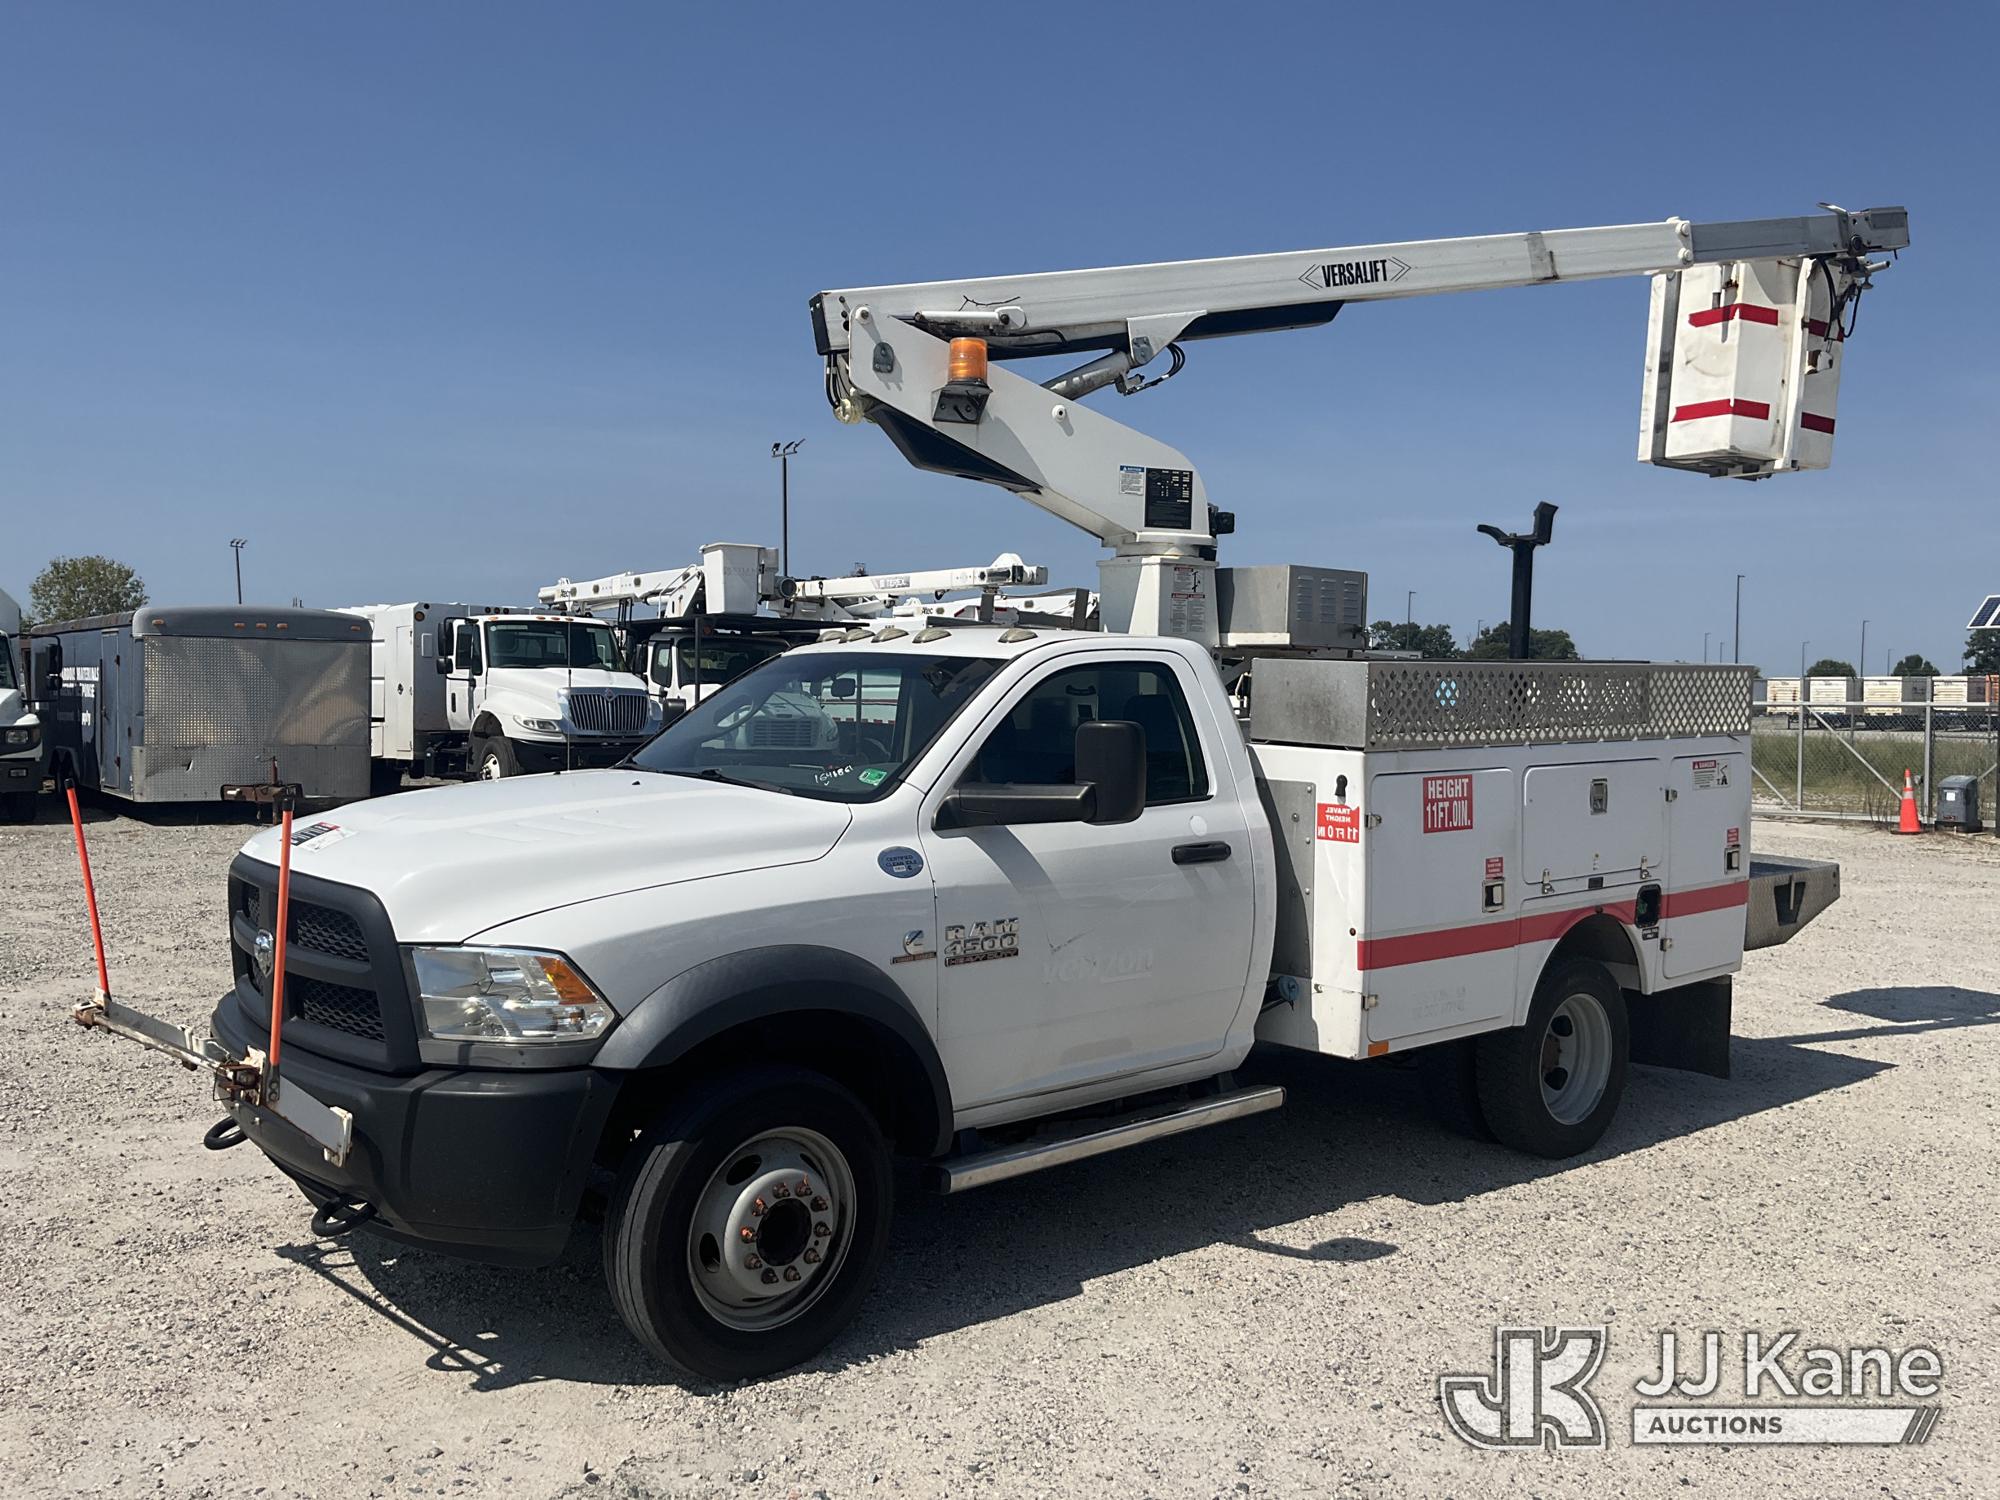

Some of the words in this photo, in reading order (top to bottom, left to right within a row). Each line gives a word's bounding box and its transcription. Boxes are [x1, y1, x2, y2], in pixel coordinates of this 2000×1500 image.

[1321, 259, 1388, 288] VERSALIFT
[1427, 778, 1469, 799] HEIGHT
[1426, 800, 1471, 829] 11FT.0IN.
[945, 917, 1019, 941] RAM
[944, 933, 1019, 956] 4500
